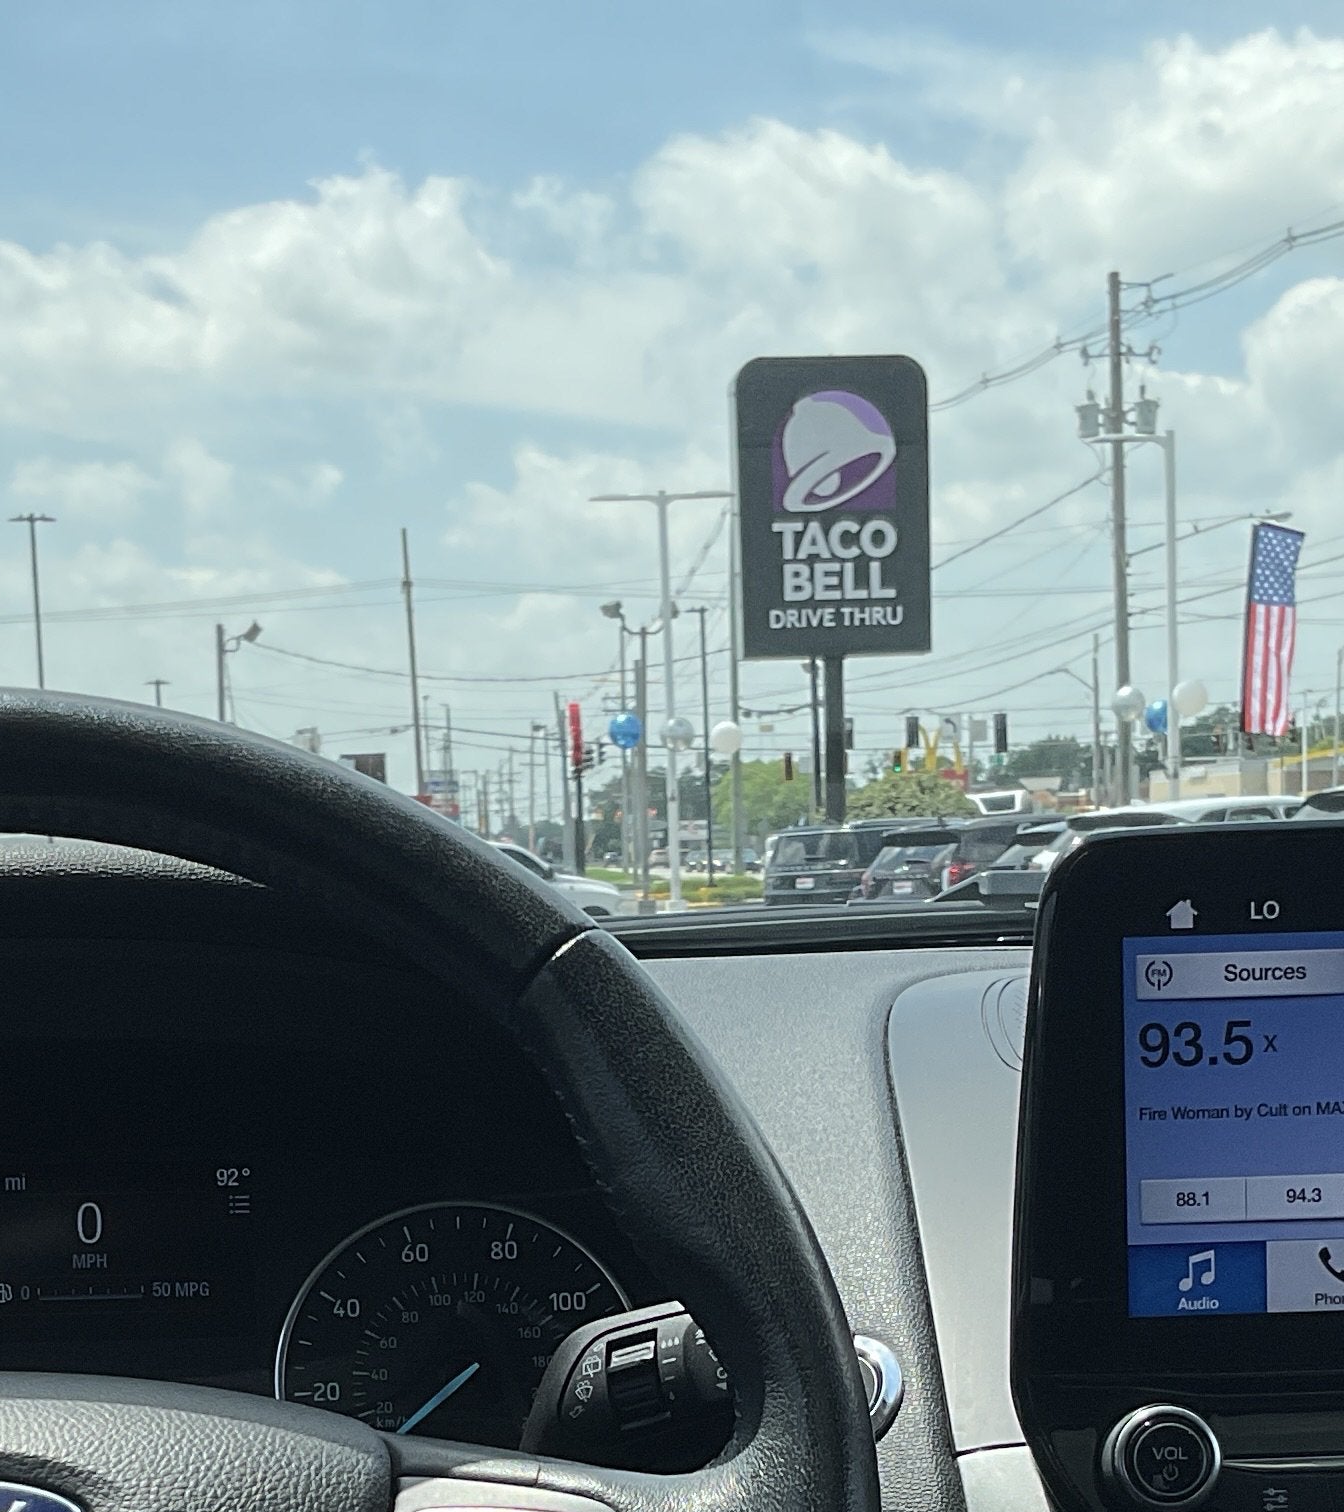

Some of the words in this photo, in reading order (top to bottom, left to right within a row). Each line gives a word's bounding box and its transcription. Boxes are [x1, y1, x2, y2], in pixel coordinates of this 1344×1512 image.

[771, 520, 898, 560] TACO
[783, 561, 897, 601] BELL
[769, 608, 836, 629] DRIVE
[840, 606, 904, 626] THRU
[1250, 901, 1280, 919] LO
[1223, 963, 1307, 983] Sources
[1138, 1020, 1254, 1068] 93.5
[1138, 1106, 1167, 1121] Fire
[1171, 1105, 1230, 1120] Woman
[1234, 1103, 1252, 1120] by
[1257, 1102, 1288, 1118] Cult
[1292, 1105, 1312, 1116] on
[5, 1173, 26, 1191] mi
[216, 1168, 250, 1186] 92°
[1176, 1191, 1210, 1207] 88.1
[1286, 1188, 1322, 1203] 94.3
[76, 1202, 102, 1244] 0
[401, 1243, 429, 1262] 60
[490, 1241, 517, 1260] 80
[72, 1254, 107, 1269] MPH
[152, 1282, 171, 1297] 50
[175, 1282, 210, 1297] MPG
[463, 1290, 485, 1303] 120
[333, 1299, 360, 1317] 40
[428, 1293, 451, 1306] 100
[549, 1292, 586, 1311] 100
[1177, 1296, 1219, 1310] Audio
[496, 1302, 518, 1315] 140
[401, 1311, 419, 1324] 80
[517, 1326, 541, 1339] 160
[380, 1337, 397, 1349] 60
[371, 1369, 388, 1381] 40
[313, 1383, 340, 1400] 20
[375, 1402, 393, 1414] 20
[1152, 1446, 1188, 1460] VOL
